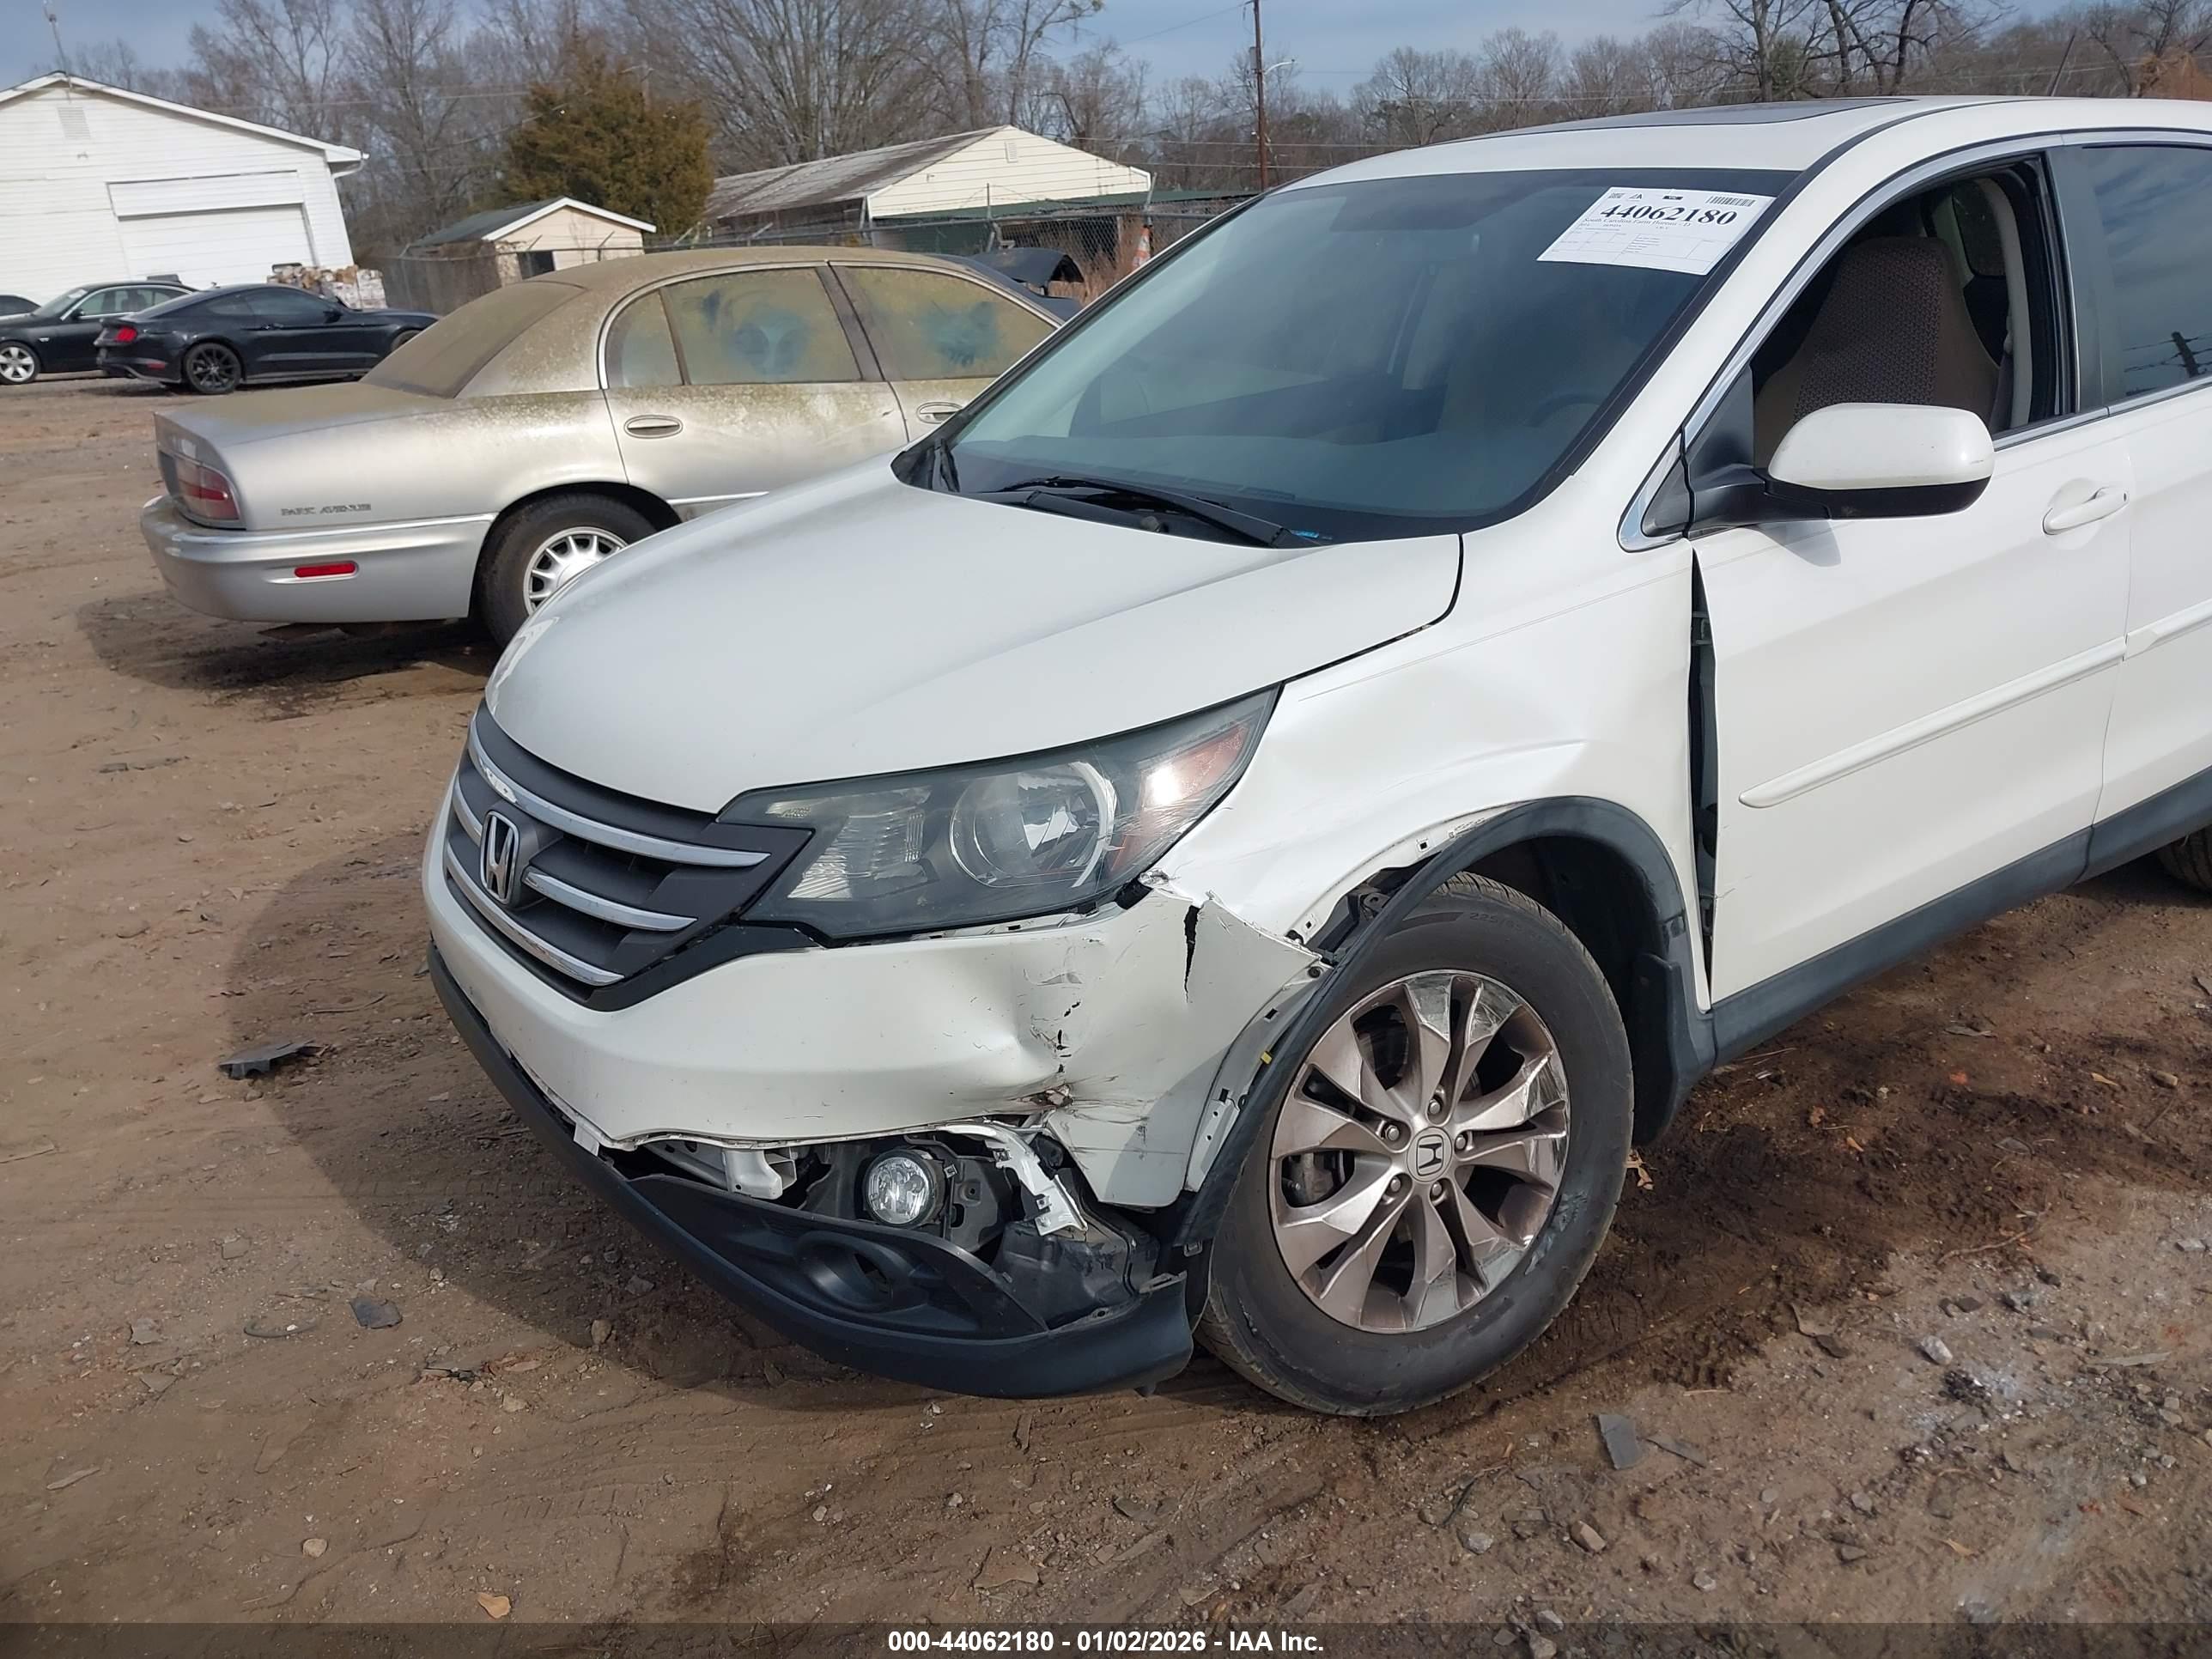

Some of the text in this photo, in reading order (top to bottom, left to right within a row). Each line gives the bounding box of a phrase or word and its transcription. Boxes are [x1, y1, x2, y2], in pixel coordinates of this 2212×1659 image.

[1600, 204, 1738, 225] 44062180
[281, 503, 372, 516] PARK AVENUE
